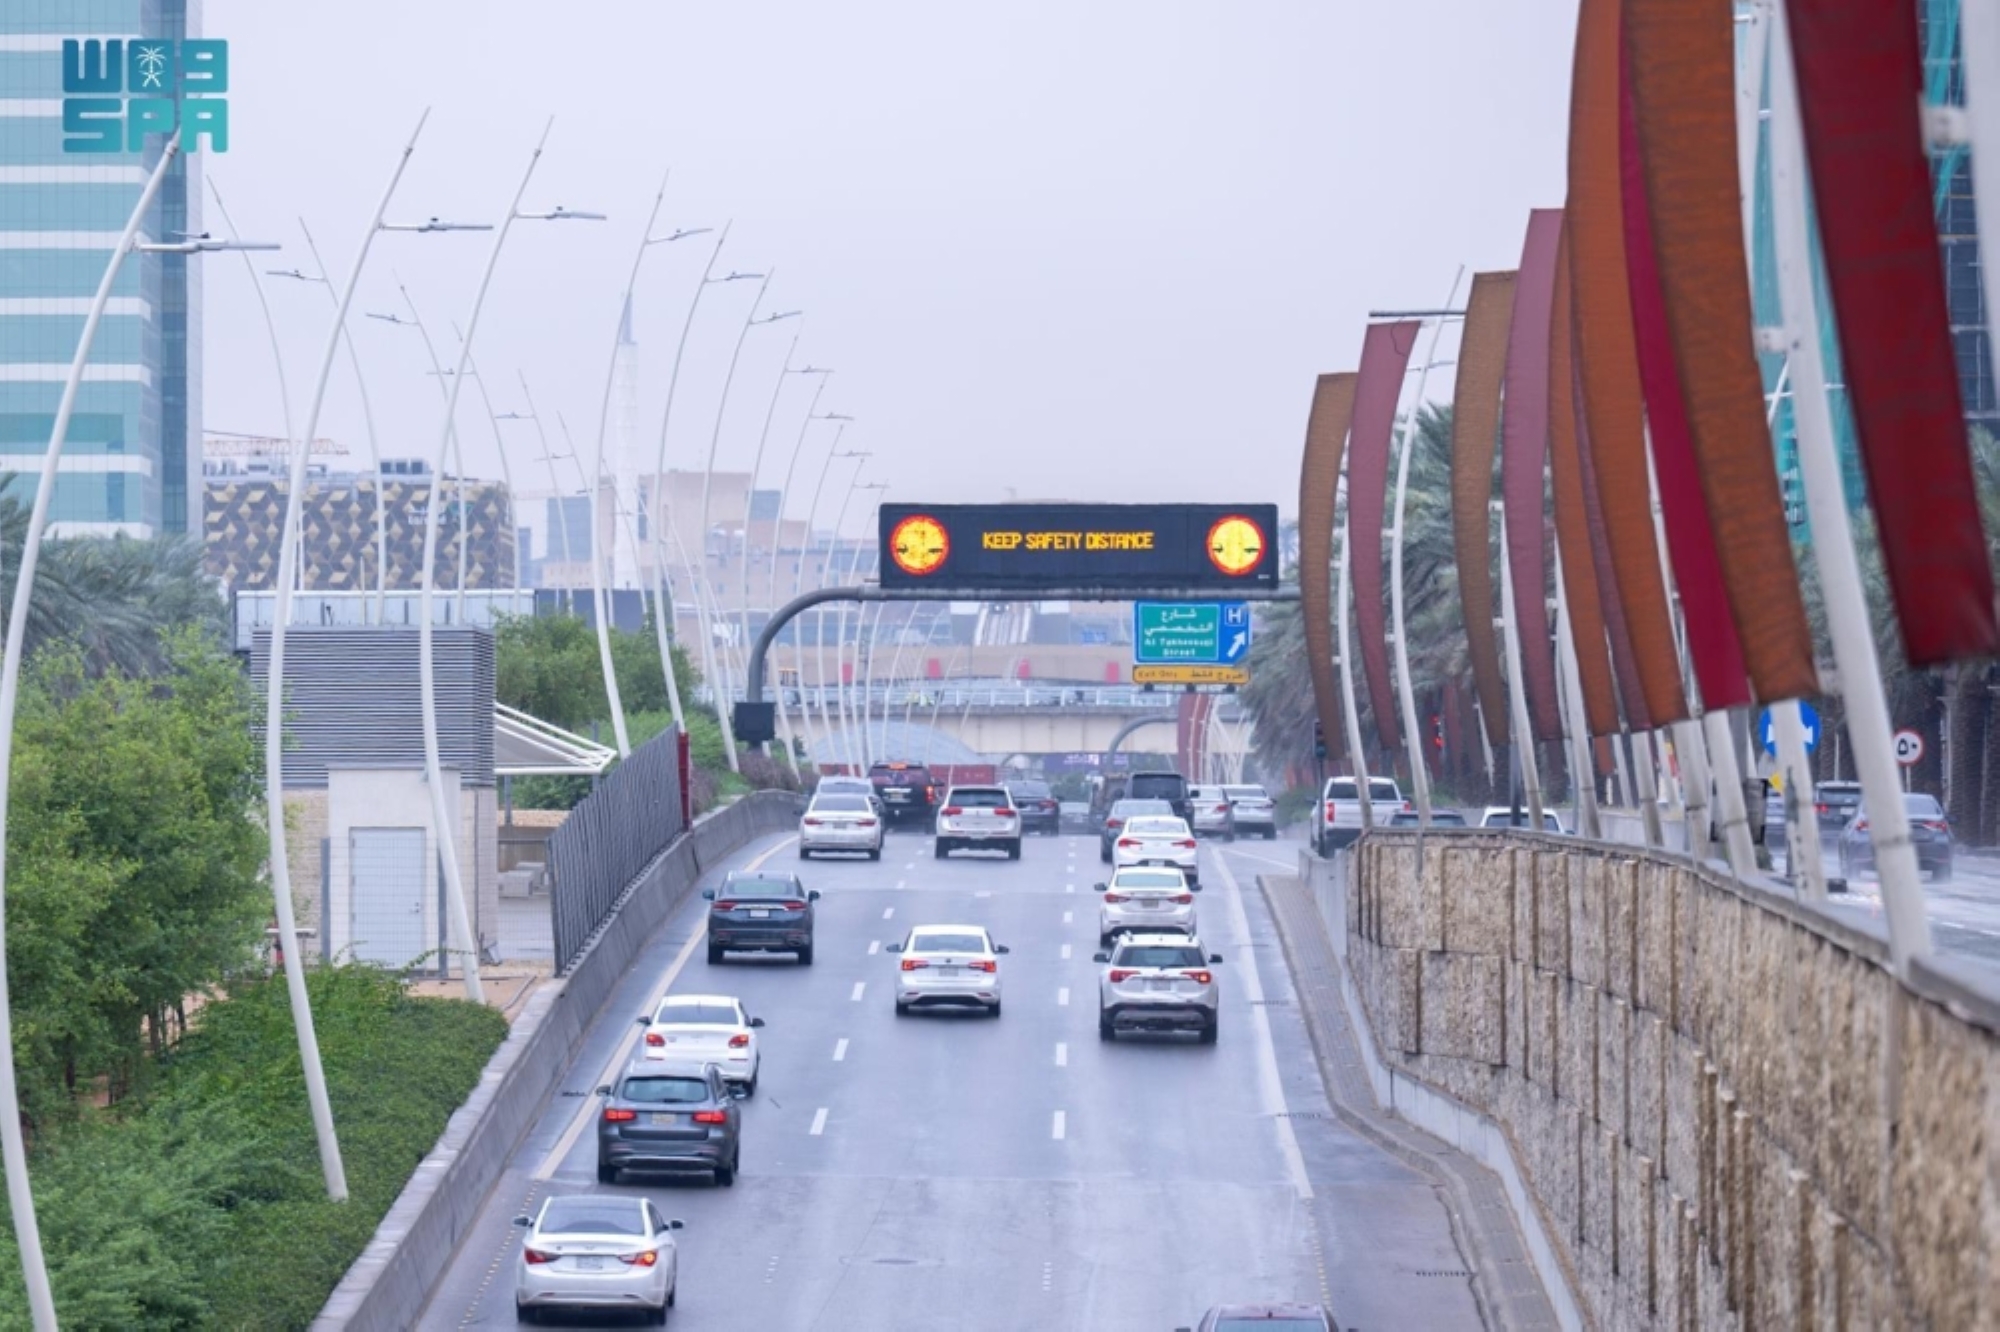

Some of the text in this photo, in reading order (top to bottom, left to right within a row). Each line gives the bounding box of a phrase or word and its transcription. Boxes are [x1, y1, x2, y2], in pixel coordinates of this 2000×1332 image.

[983, 532, 1154, 549] KEEP SAFETY DISTANCE
[1161, 607, 1197, 623] شارع
[1144, 622, 1214, 637] التخصصي
[1163, 648, 1195, 657] Street
